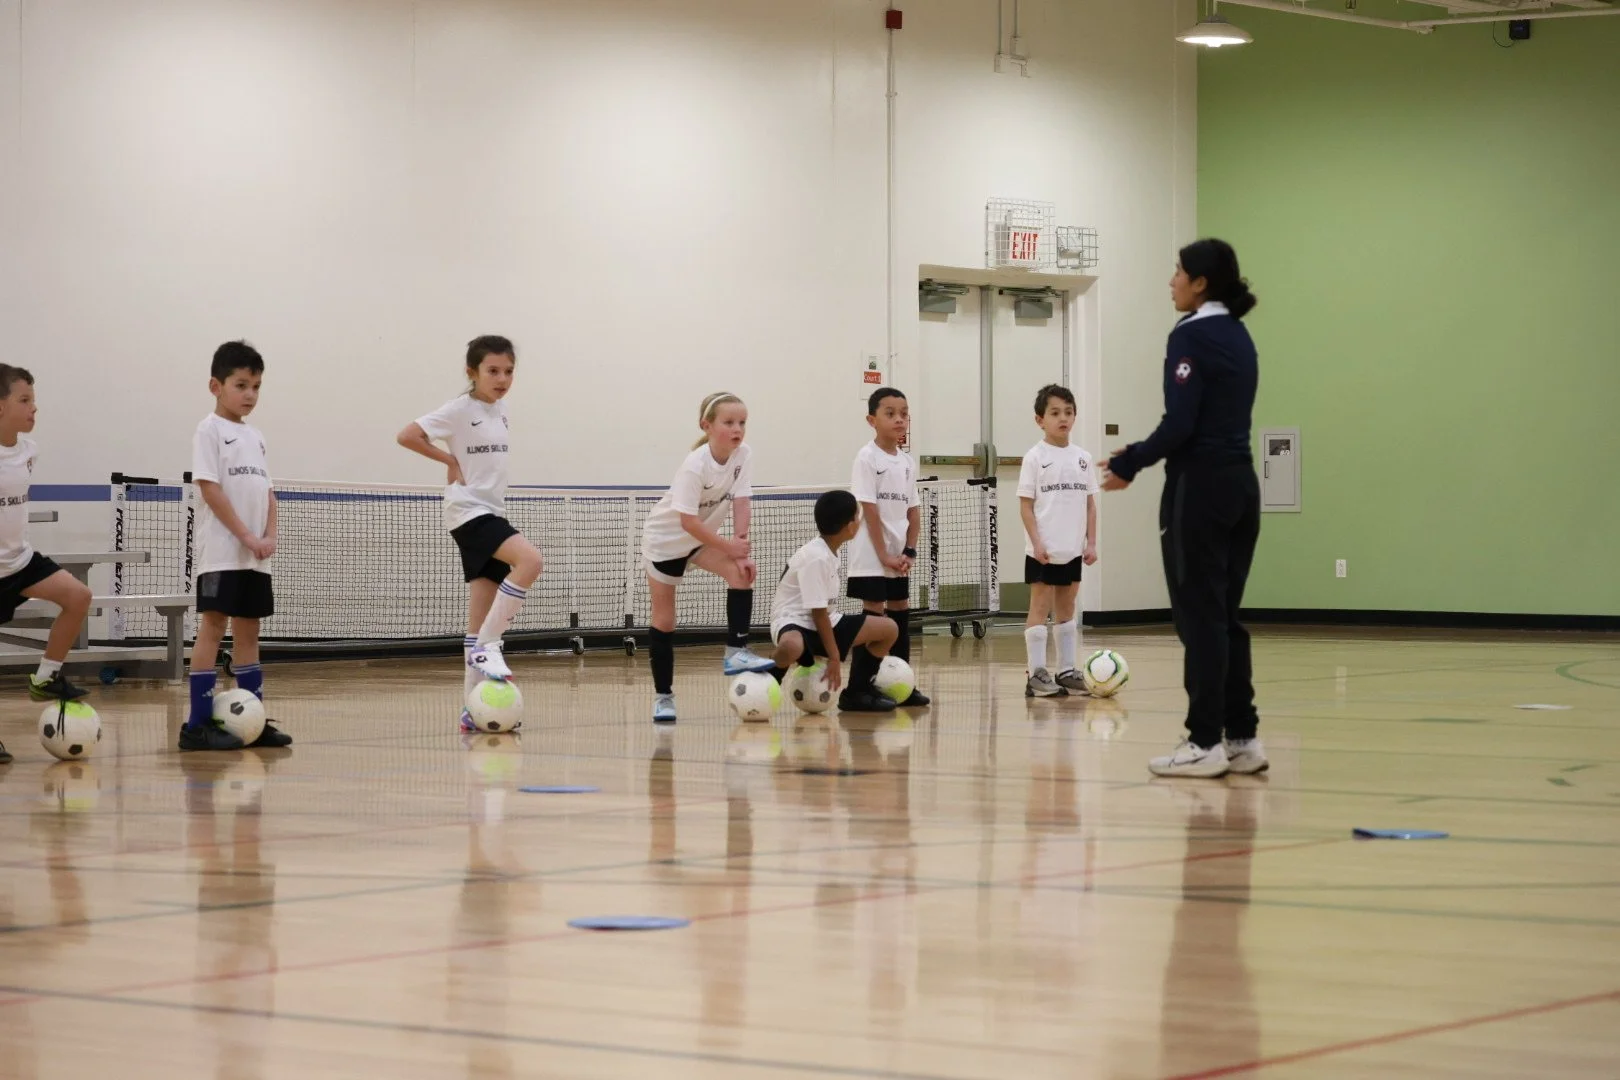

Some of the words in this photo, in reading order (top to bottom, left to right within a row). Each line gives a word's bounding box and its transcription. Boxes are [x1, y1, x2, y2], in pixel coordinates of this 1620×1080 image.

[1012, 231, 1038, 260] EXIT
[467, 445, 490, 454] ILLINOIS
[1041, 483, 1060, 492] ILLINOIS
[1061, 483, 1073, 491] SKILL
[1073, 483, 1088, 491] SCHOOL
[930, 564, 938, 590] Deluxe
